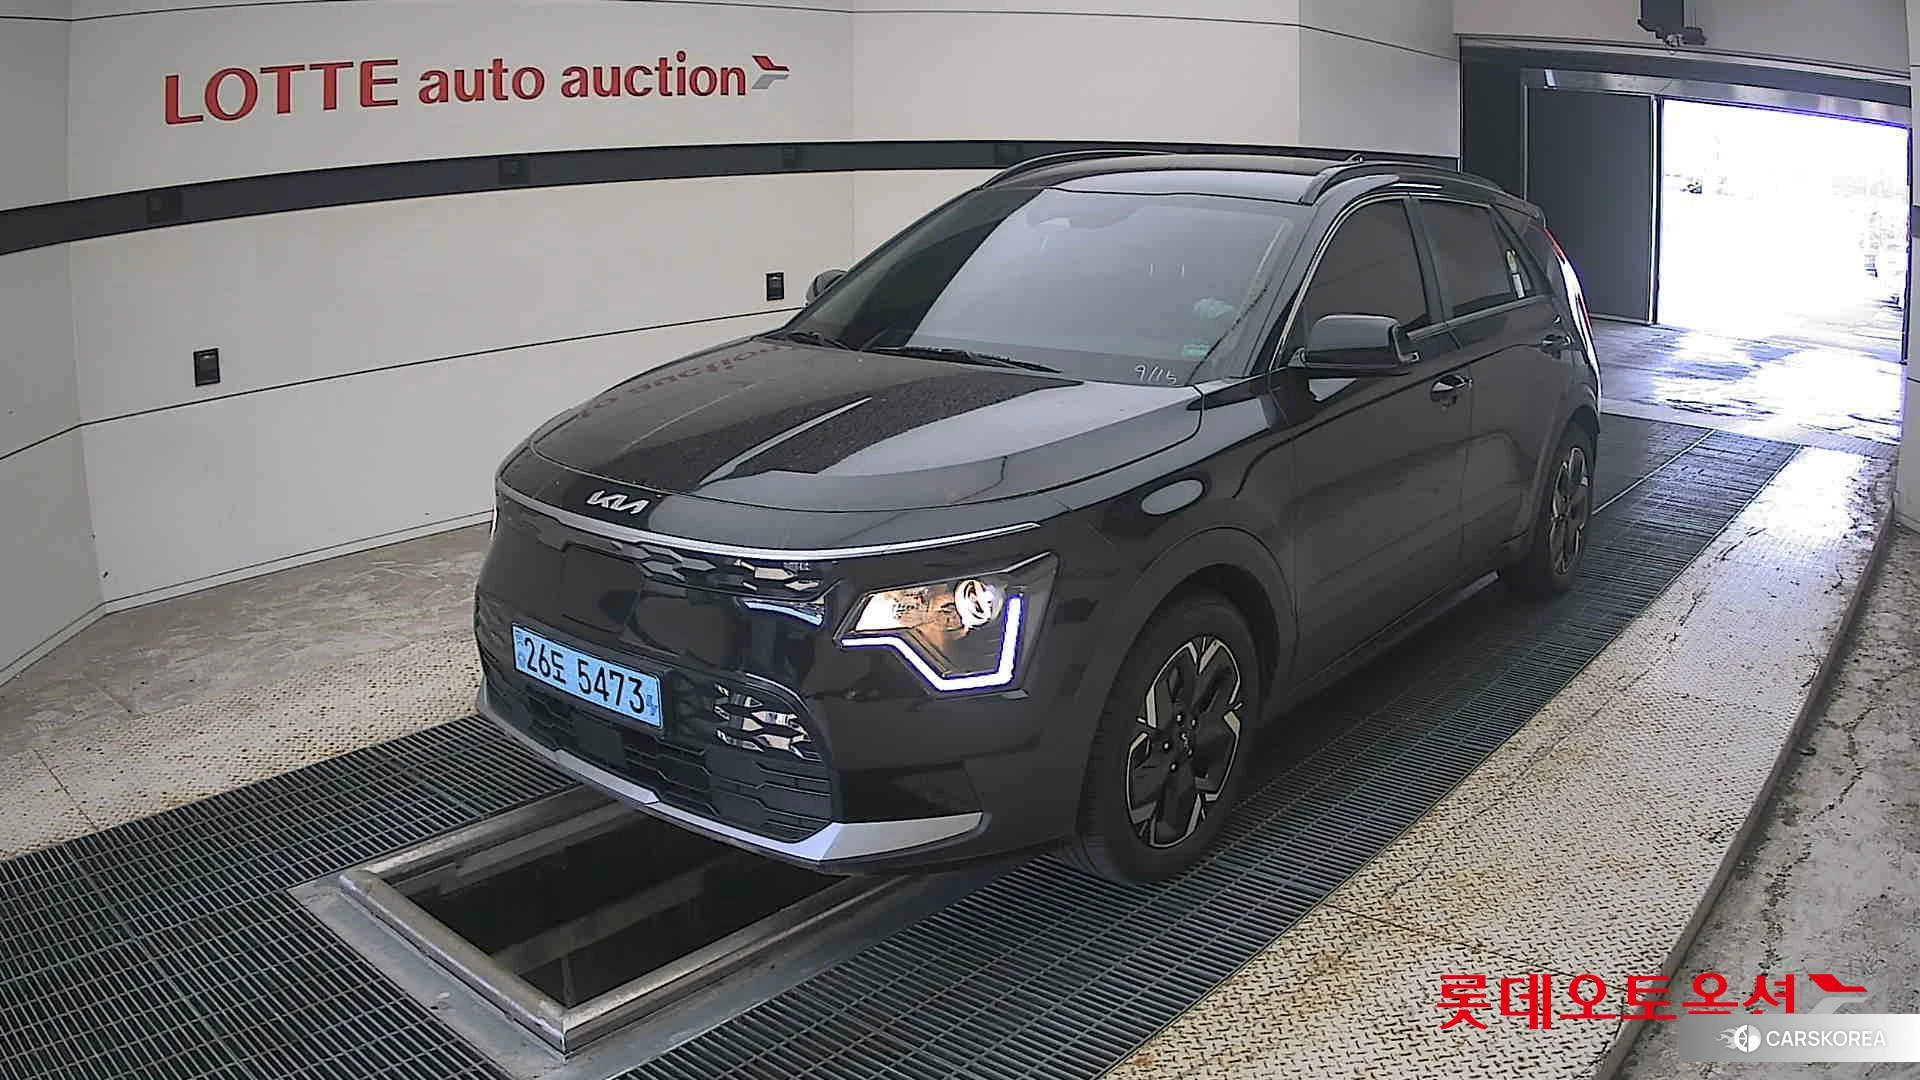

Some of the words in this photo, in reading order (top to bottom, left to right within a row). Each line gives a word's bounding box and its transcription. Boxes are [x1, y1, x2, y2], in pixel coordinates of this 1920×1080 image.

[165, 59, 398, 125] LOTTE
[418, 58, 545, 104] auto
[561, 51, 746, 98] auction
[587, 490, 648, 515] KIA
[577, 658, 645, 714] 5473
